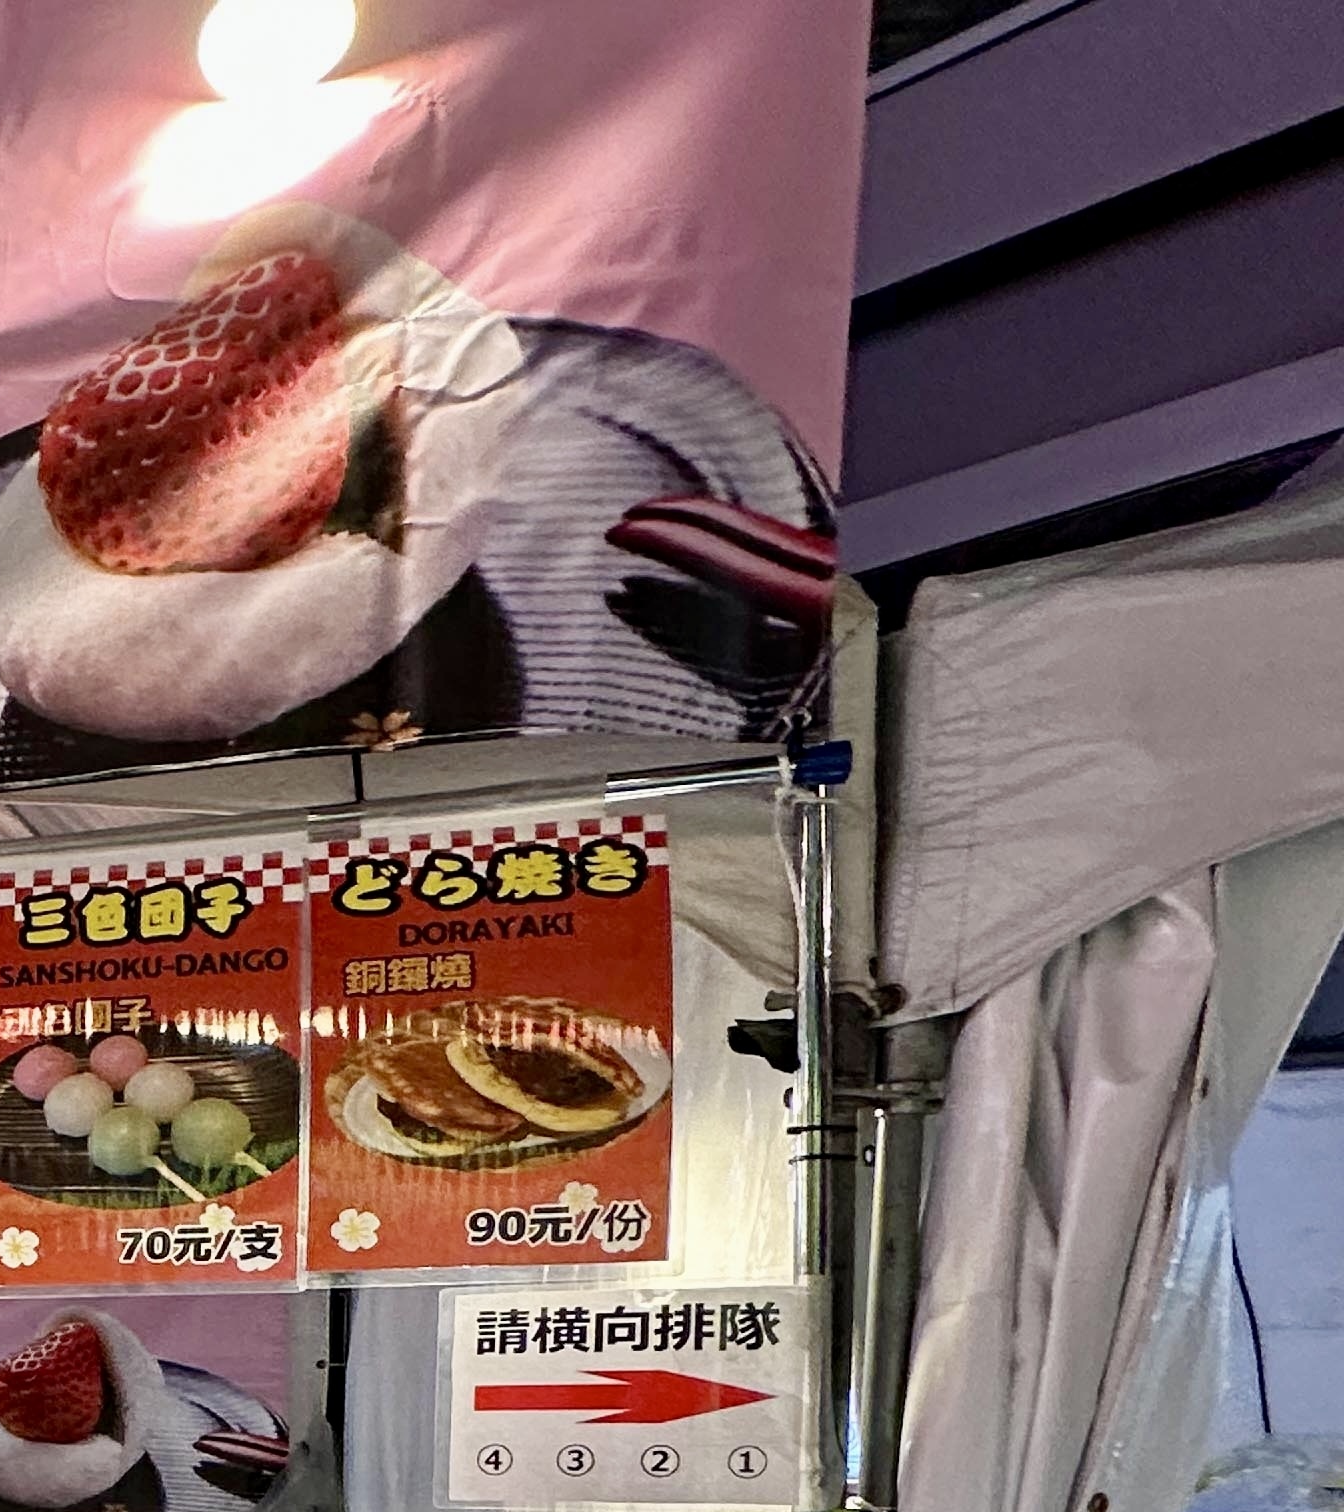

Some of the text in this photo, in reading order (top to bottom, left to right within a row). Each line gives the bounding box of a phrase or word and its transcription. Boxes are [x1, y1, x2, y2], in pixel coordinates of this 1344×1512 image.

[399, 911, 574, 947] DORAYAKI
[343, 952, 474, 996] 銅鑼燒
[1, 996, 152, 1037] 色團子
[120, 1224, 283, 1263] 70元/支
[468, 1201, 648, 1245] 90元/份
